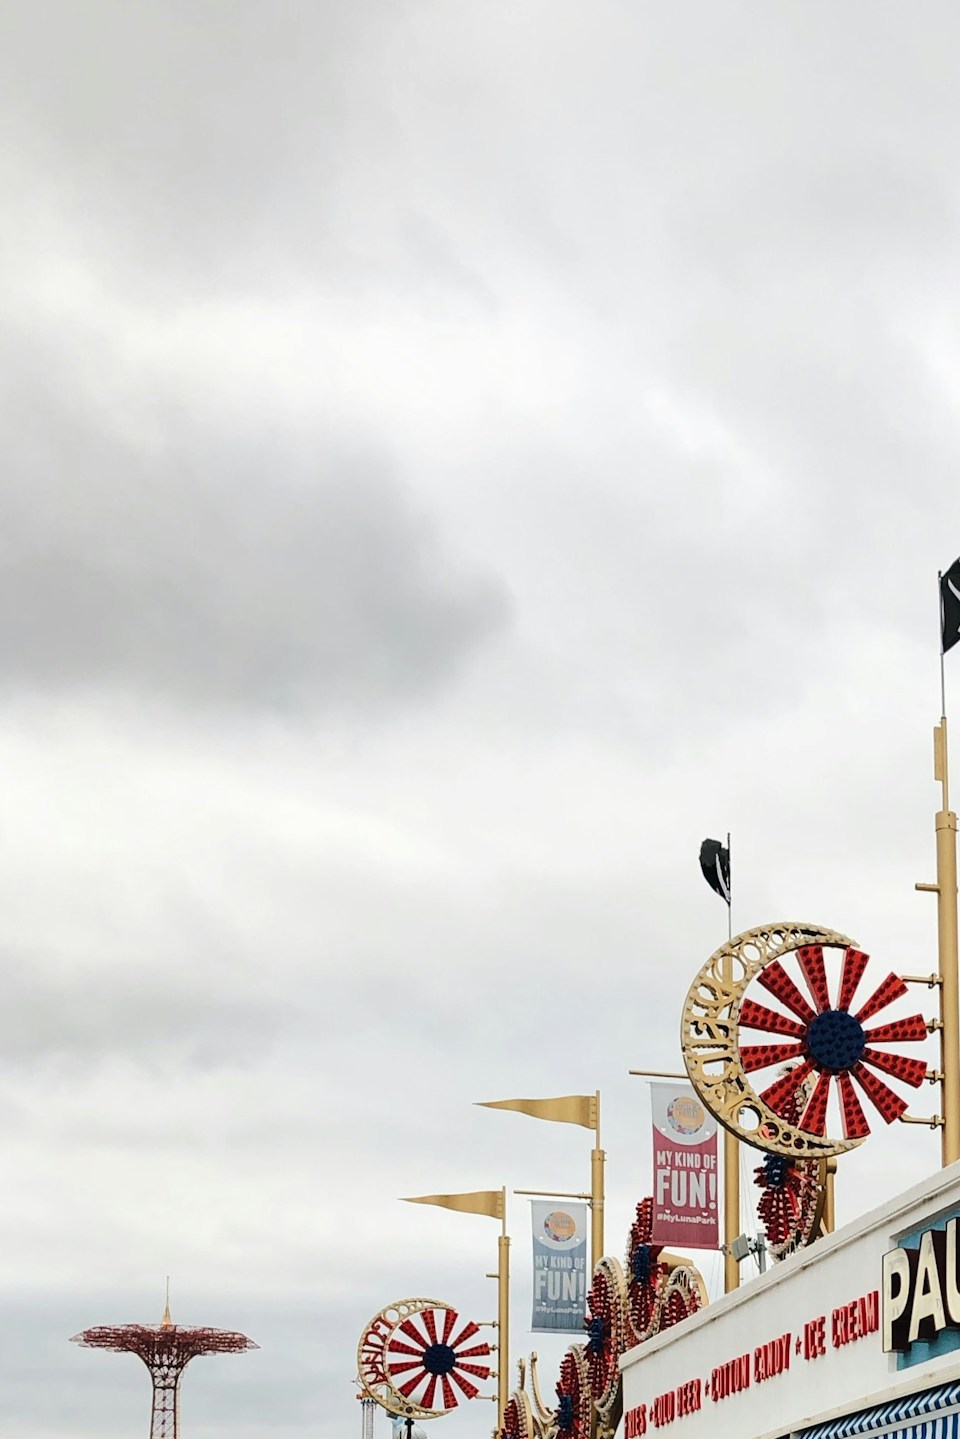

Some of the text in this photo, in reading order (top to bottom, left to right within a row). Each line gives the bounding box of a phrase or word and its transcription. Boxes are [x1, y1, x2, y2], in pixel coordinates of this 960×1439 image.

[657, 1151, 716, 1170] MY KIND OF
[657, 1169, 717, 1210] FUN!
[657, 1213, 716, 1225] #MyLunaPark
[535, 1255, 585, 1270] MY KIND OF
[535, 1270, 585, 1302] FUN!
[362, 1316, 393, 1386] LUNA
[677, 1378, 702, 1418] BEER
[711, 1352, 750, 1403] COTTON
[754, 1332, 792, 1384] CANDY
[804, 1316, 827, 1360] ICE
[832, 1290, 880, 1348] CREAM
